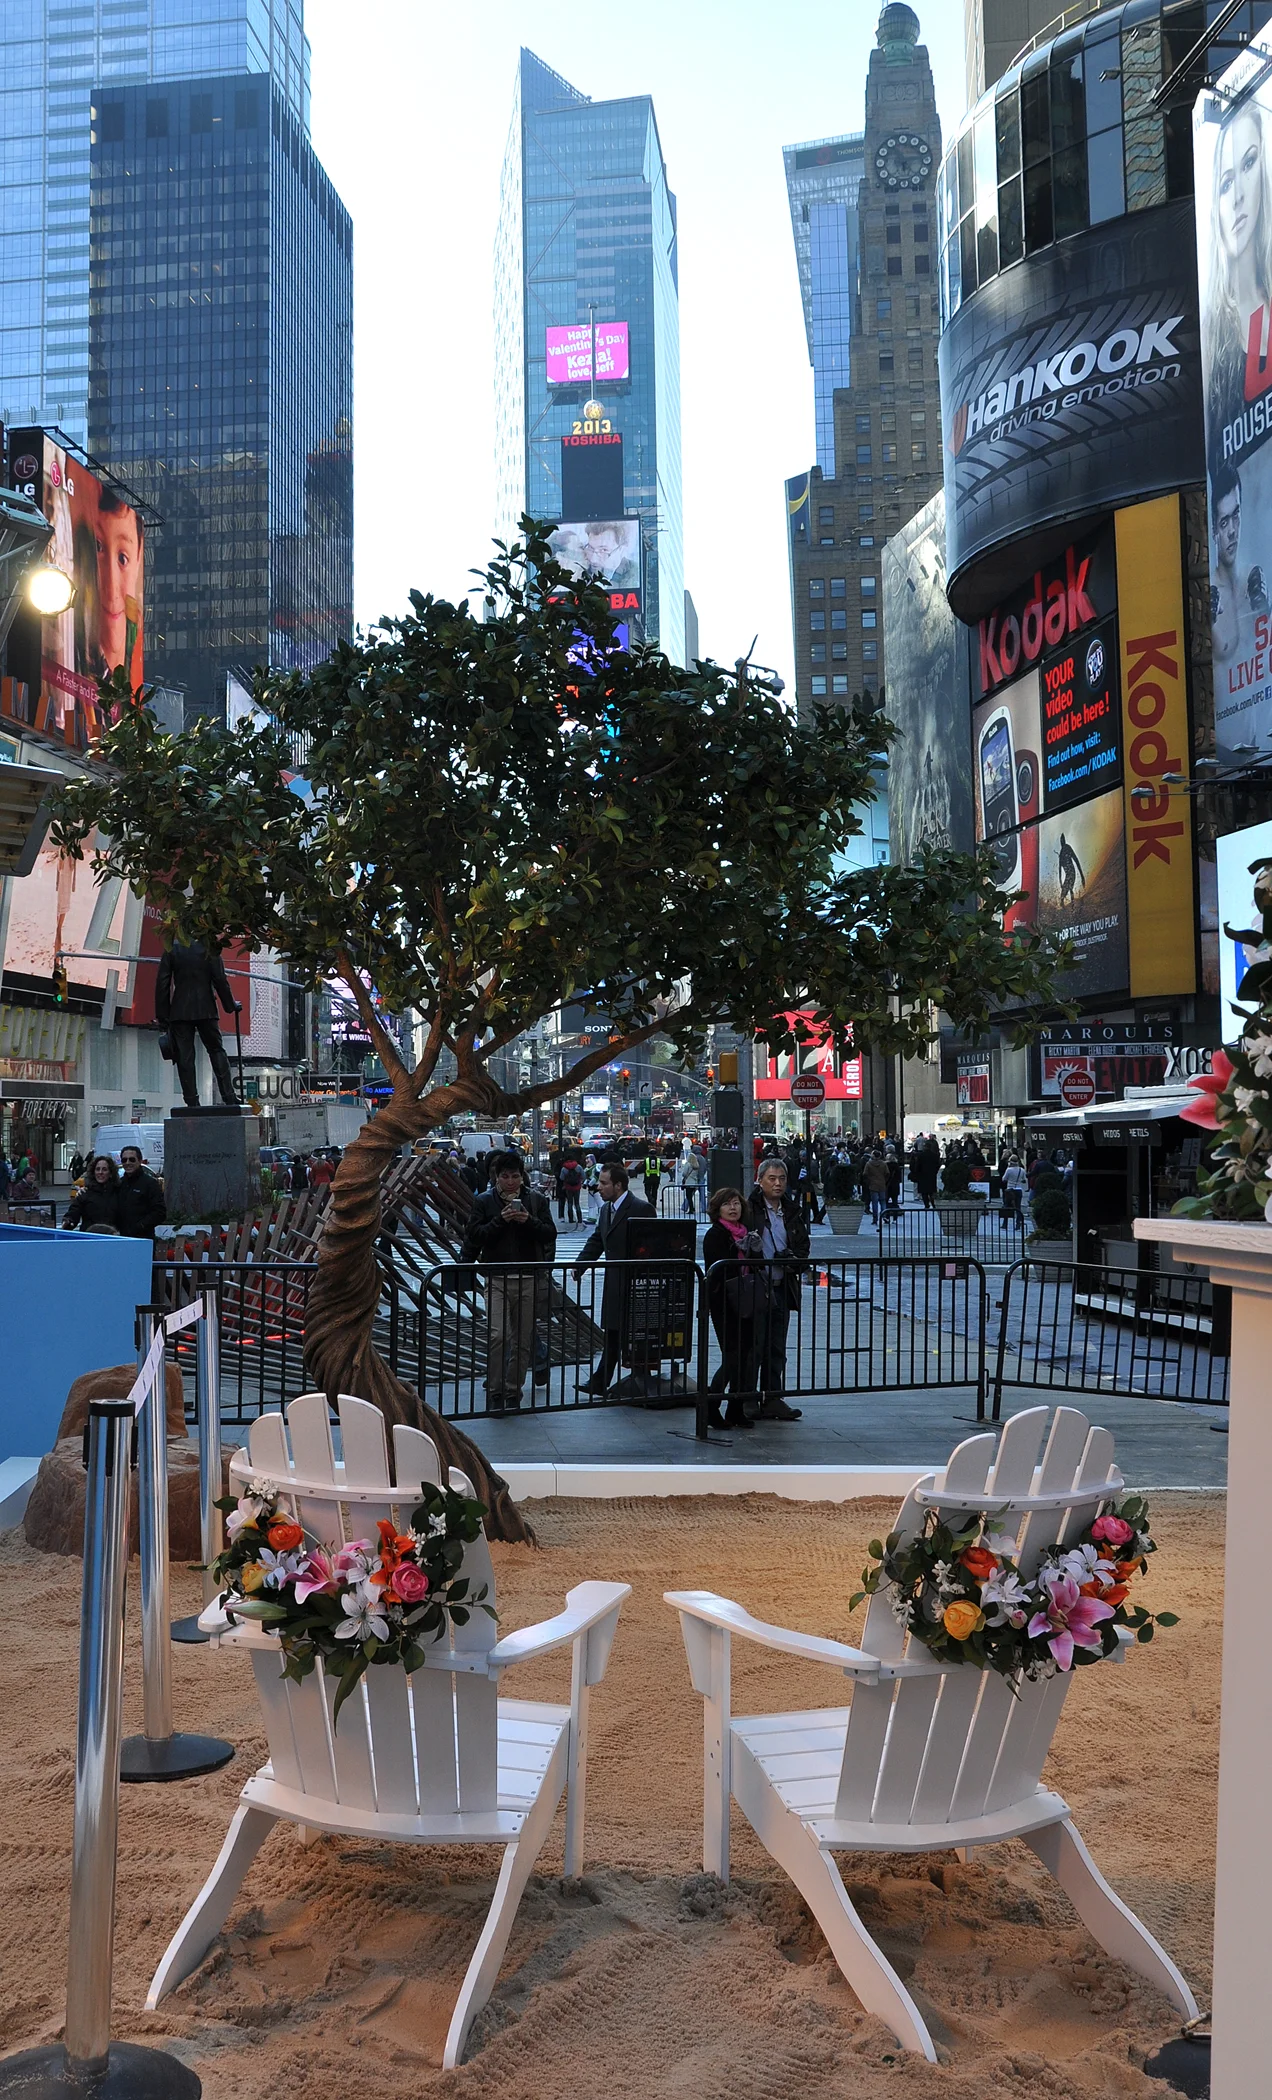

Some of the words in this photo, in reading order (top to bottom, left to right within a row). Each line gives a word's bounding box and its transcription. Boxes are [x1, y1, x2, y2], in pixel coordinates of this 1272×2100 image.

[548, 337, 604, 357] Valentin's
[605, 334, 625, 346] Day
[595, 361, 615, 374] Jeff
[989, 397, 1057, 443] driving
[1061, 361, 1181, 409] emotion
[562, 434, 621, 446] TOSHIBA
[572, 419, 611, 435] 2013
[15, 482, 35, 496] LG
[62, 479, 75, 497] LG
[979, 545, 1097, 692] Kodak
[56, 672, 63, 683] A
[62, 673, 79, 693] Faster
[79, 683, 91, 698] and
[1045, 657, 1075, 693] YOUR
[1228, 653, 1264, 694] LIVE
[1045, 689, 1073, 719] video
[1046, 717, 1069, 745] could
[1070, 710, 1082, 732] be
[1047, 750, 1060, 769] Find
[1060, 746, 1071, 763] out
[1085, 732, 1101, 750] visit:
[1126, 630, 1184, 871] Kodak
[1048, 746, 1117, 793] Facebook.com/KODAK
[1069, 925, 1080, 938] THE
[1080, 922, 1092, 935] WAY
[1092, 918, 1105, 932] YOU
[0, 1003, 87, 1063] FOREVER
[1040, 1027, 1173, 1041] MARQUIS
[957, 1052, 990, 1065] MARQUIS
[1094, 1056, 1167, 1092] EVITA
[21, 1099, 58, 1119] FOREVER
